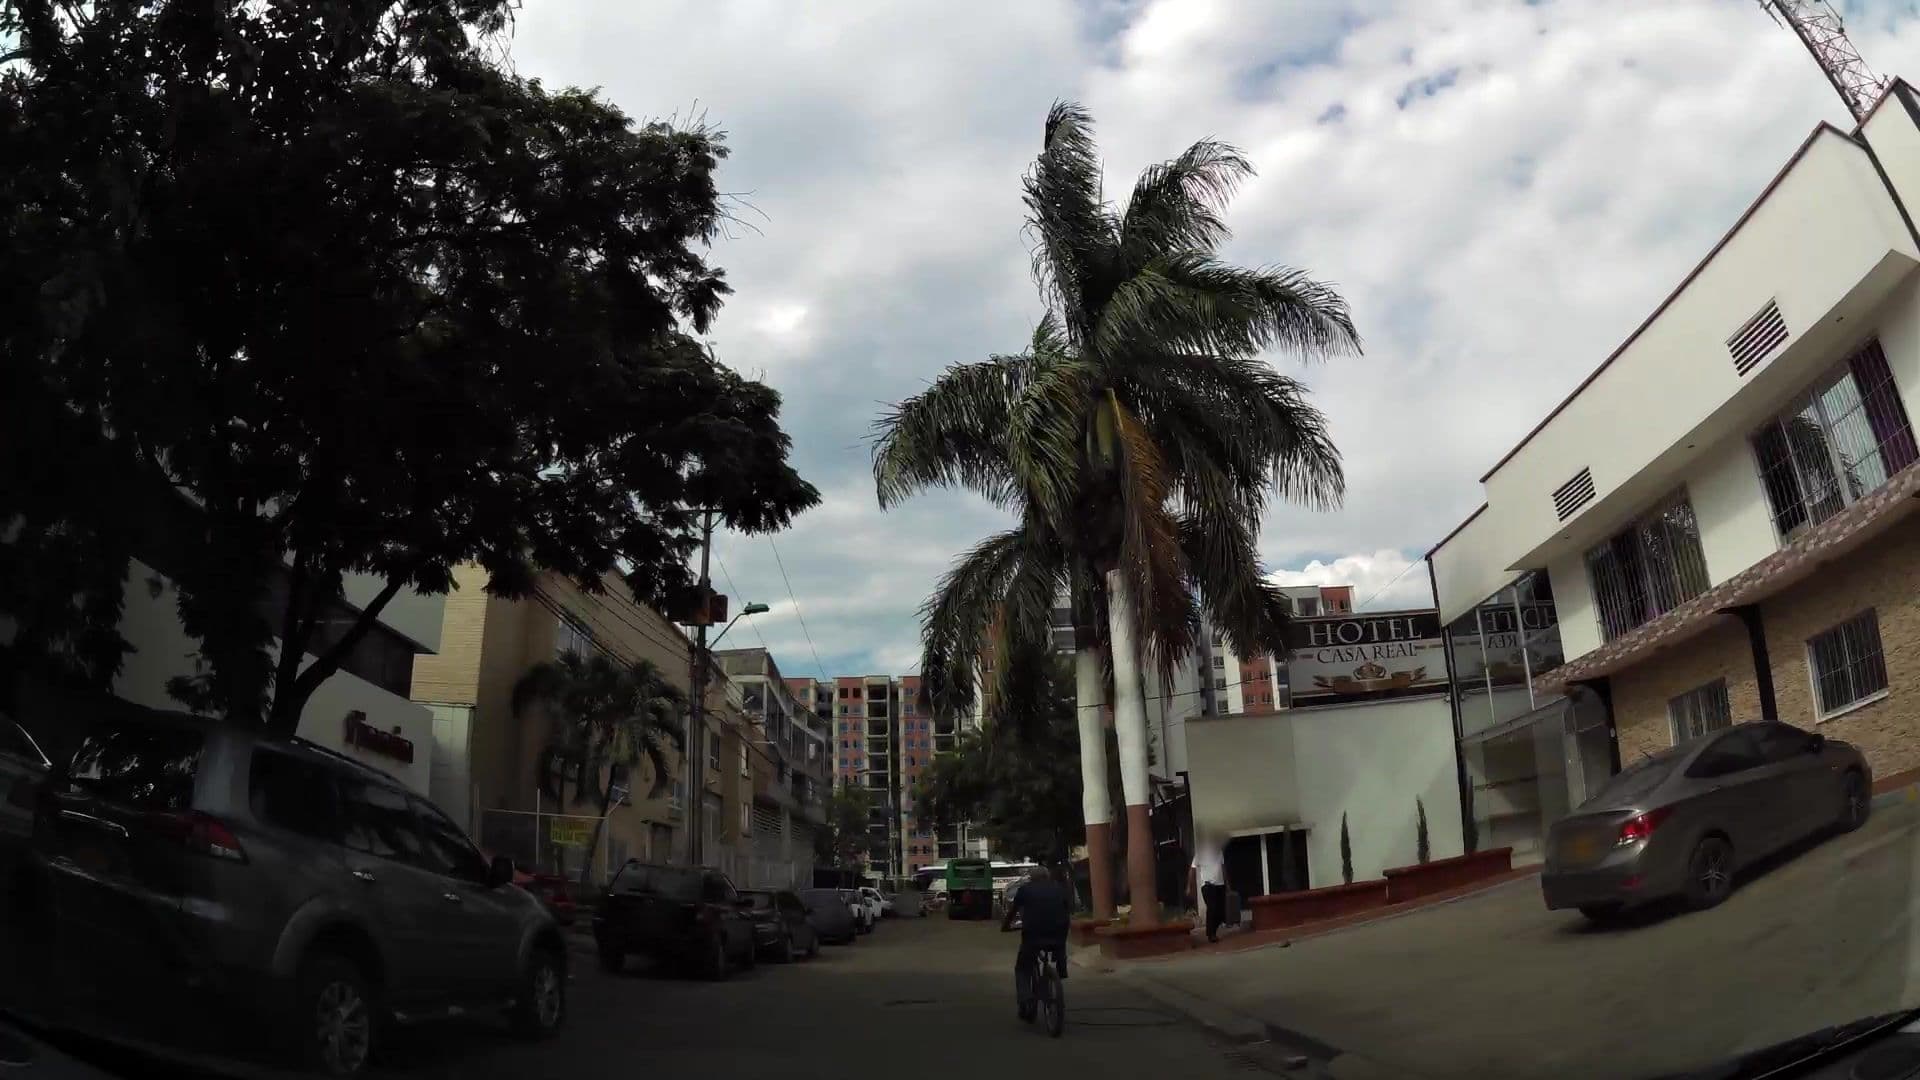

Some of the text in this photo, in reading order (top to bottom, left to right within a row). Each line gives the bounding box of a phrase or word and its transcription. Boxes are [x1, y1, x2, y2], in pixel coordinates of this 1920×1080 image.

[1306, 618, 1422, 646] HOTEL
[1317, 643, 1418, 663] CASA REAL
